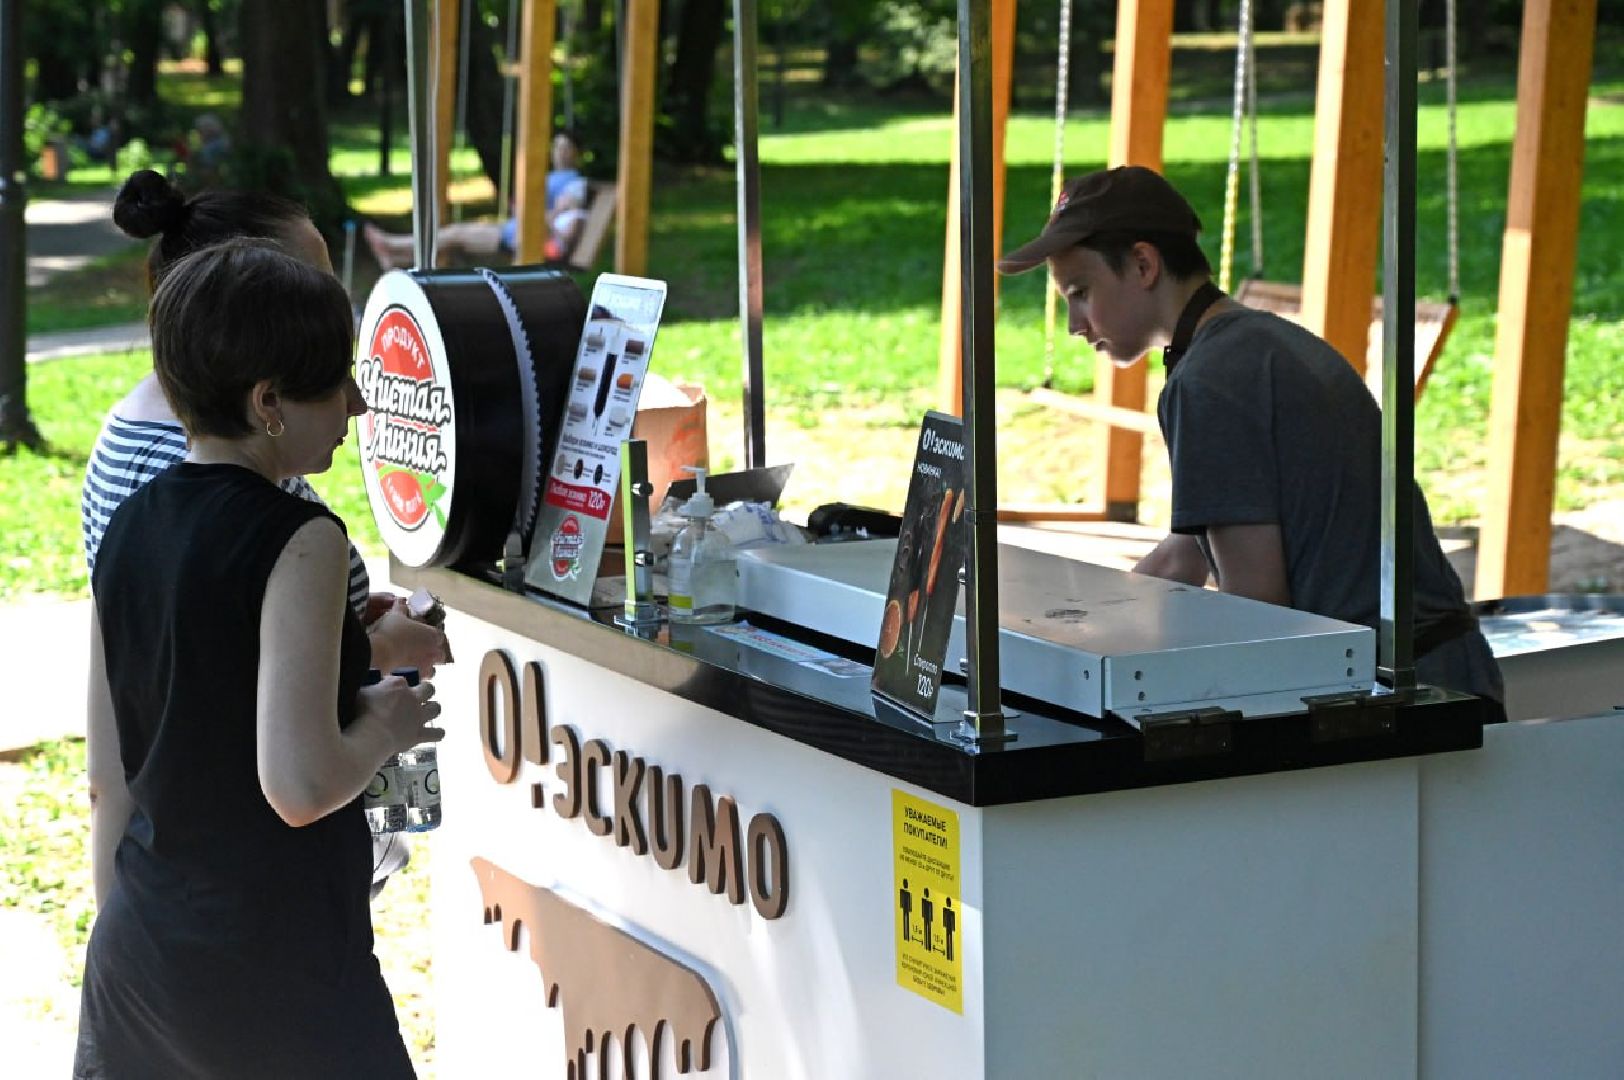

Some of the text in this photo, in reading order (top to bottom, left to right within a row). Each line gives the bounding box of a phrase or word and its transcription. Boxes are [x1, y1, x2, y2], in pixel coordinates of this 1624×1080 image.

[381, 325, 426, 370] ПРОДУКТ
[361, 357, 451, 425] Чистая
[366, 410, 447, 474] Линия
[903, 822, 948, 850] ПОКУПАТЕЛИ!
[904, 805, 947, 833] УВАЖАЕМЫЕ
